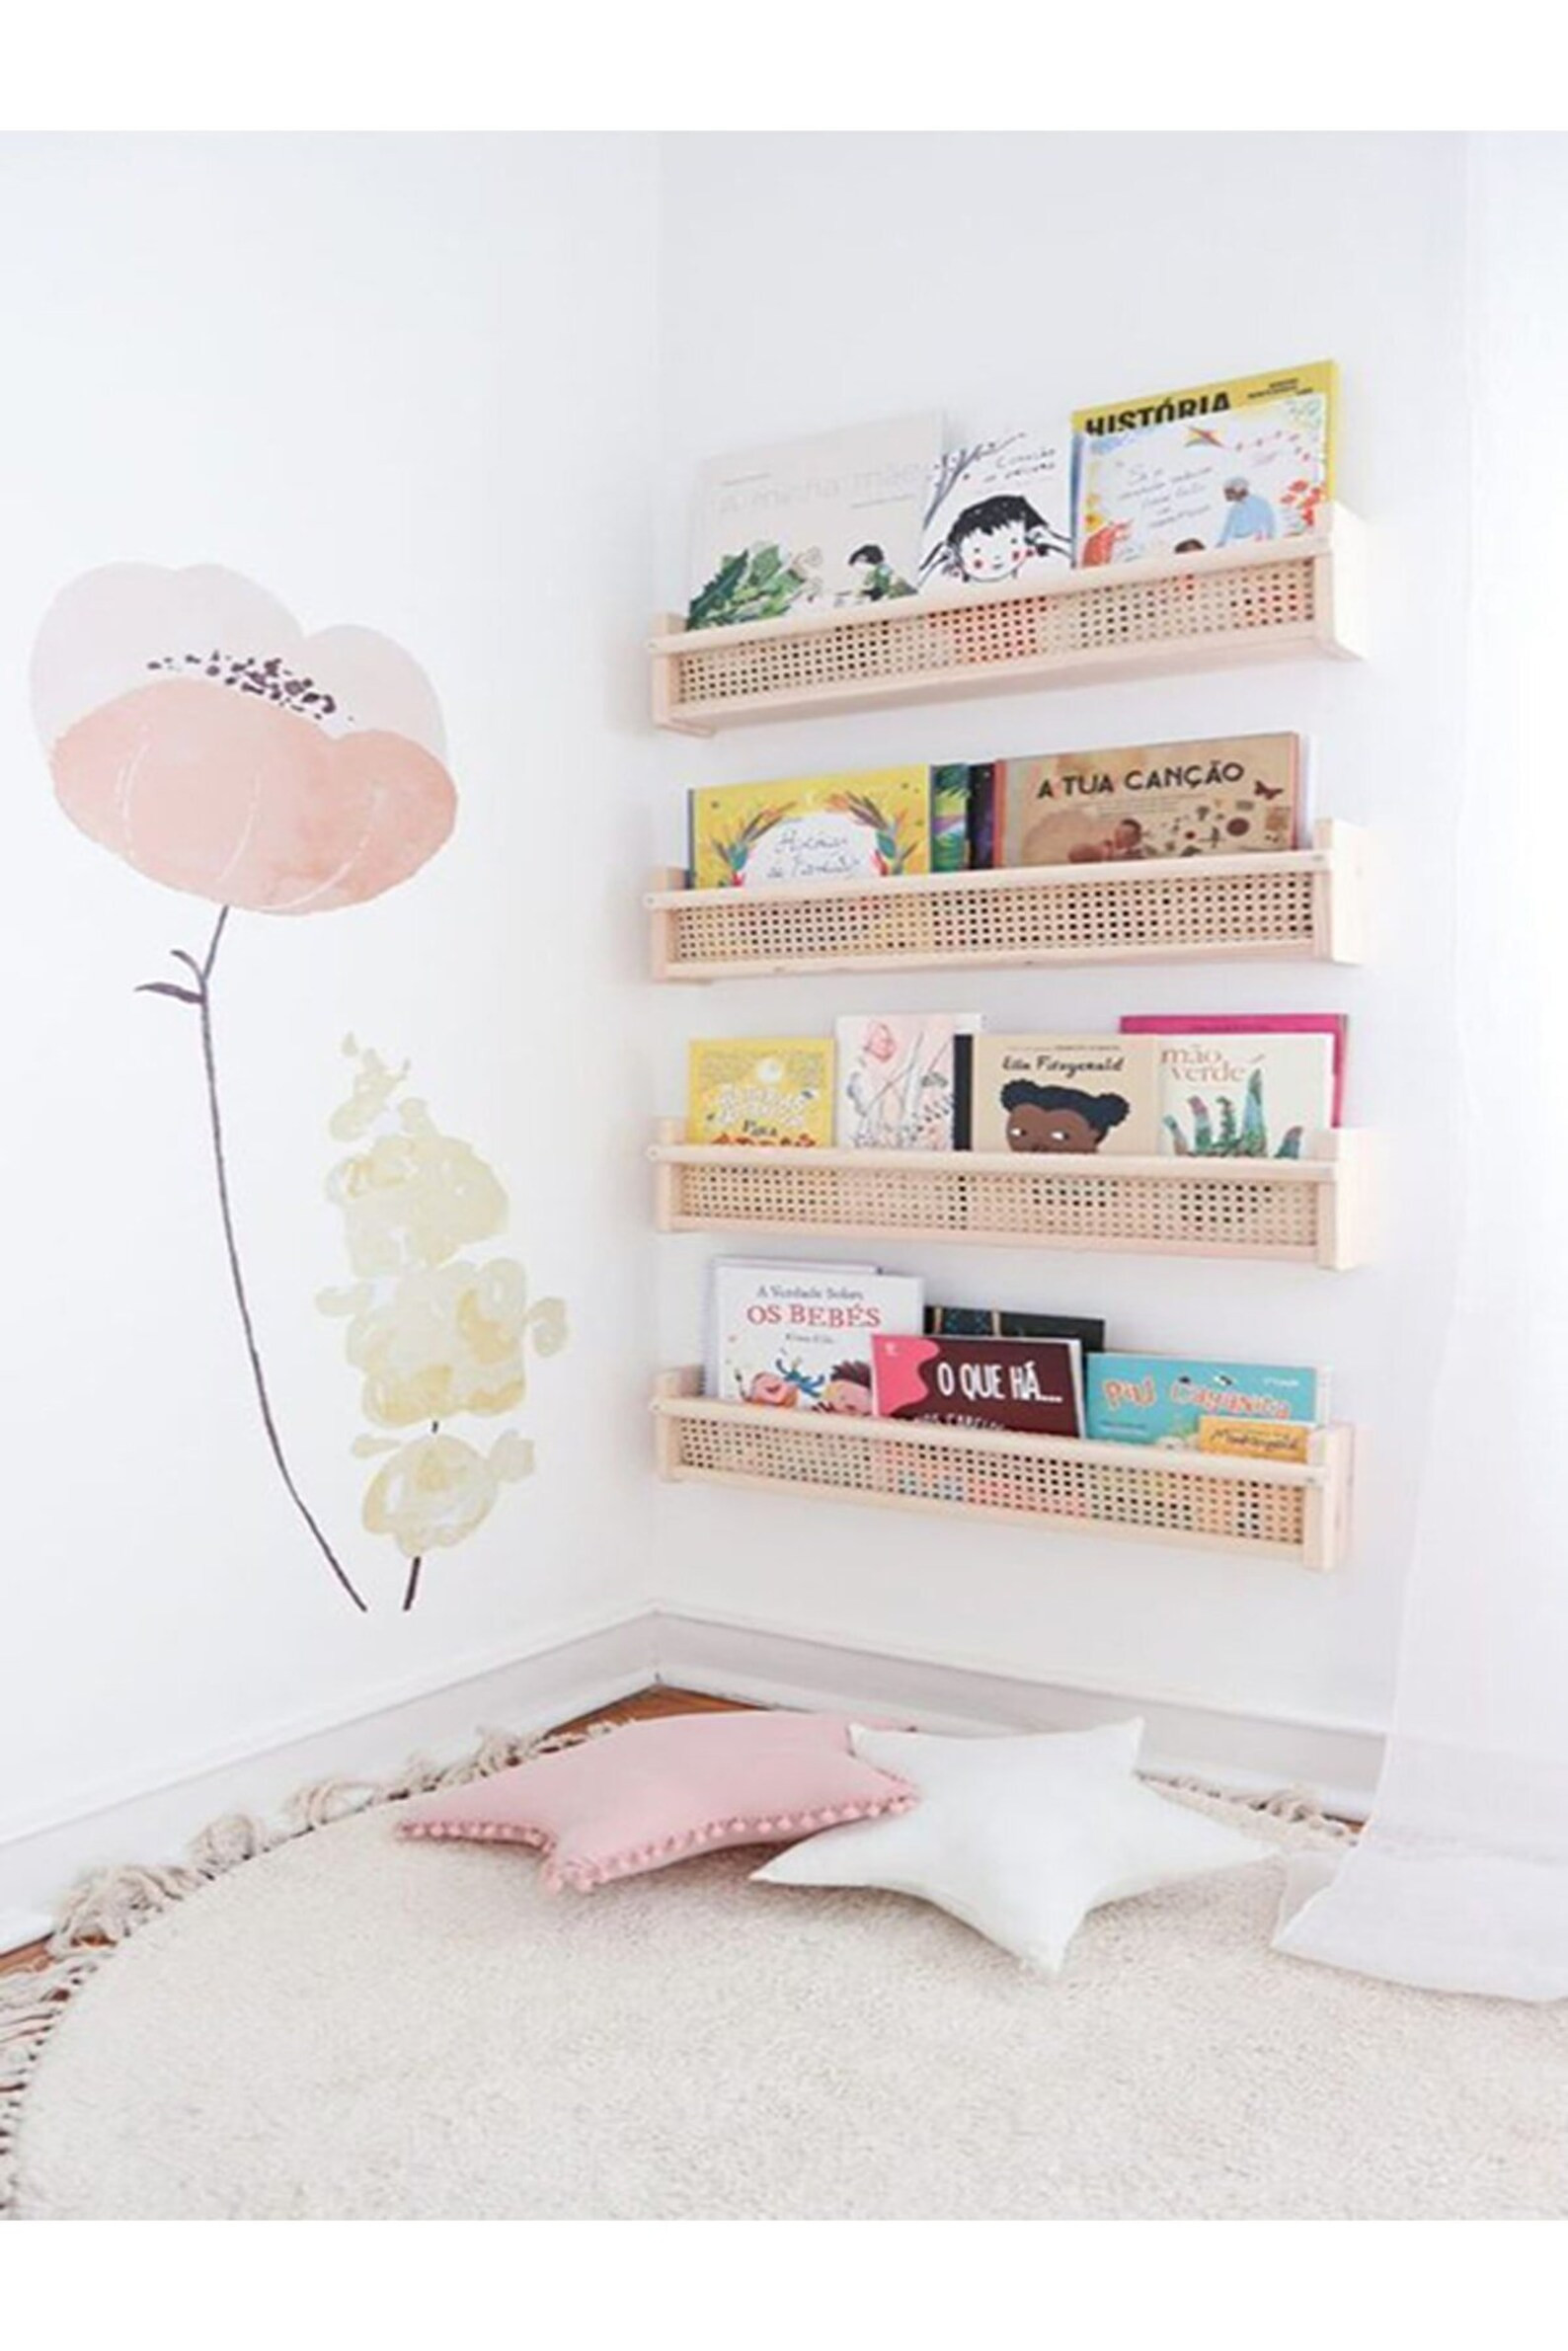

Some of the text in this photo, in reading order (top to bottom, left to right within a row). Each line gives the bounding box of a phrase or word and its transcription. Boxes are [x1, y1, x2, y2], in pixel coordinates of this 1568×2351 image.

[1086, 392, 1230, 436] HISTÓRIA
[1037, 759, 1245, 799] A TUA CANÇÃO
[1160, 1043, 1222, 1064] mão
[1171, 1060, 1246, 1083] verde
[756, 1285, 769, 1299] A
[745, 1301, 882, 1329] OS BEBÉS
[938, 1360, 1063, 1403] O QUE HÁ...
